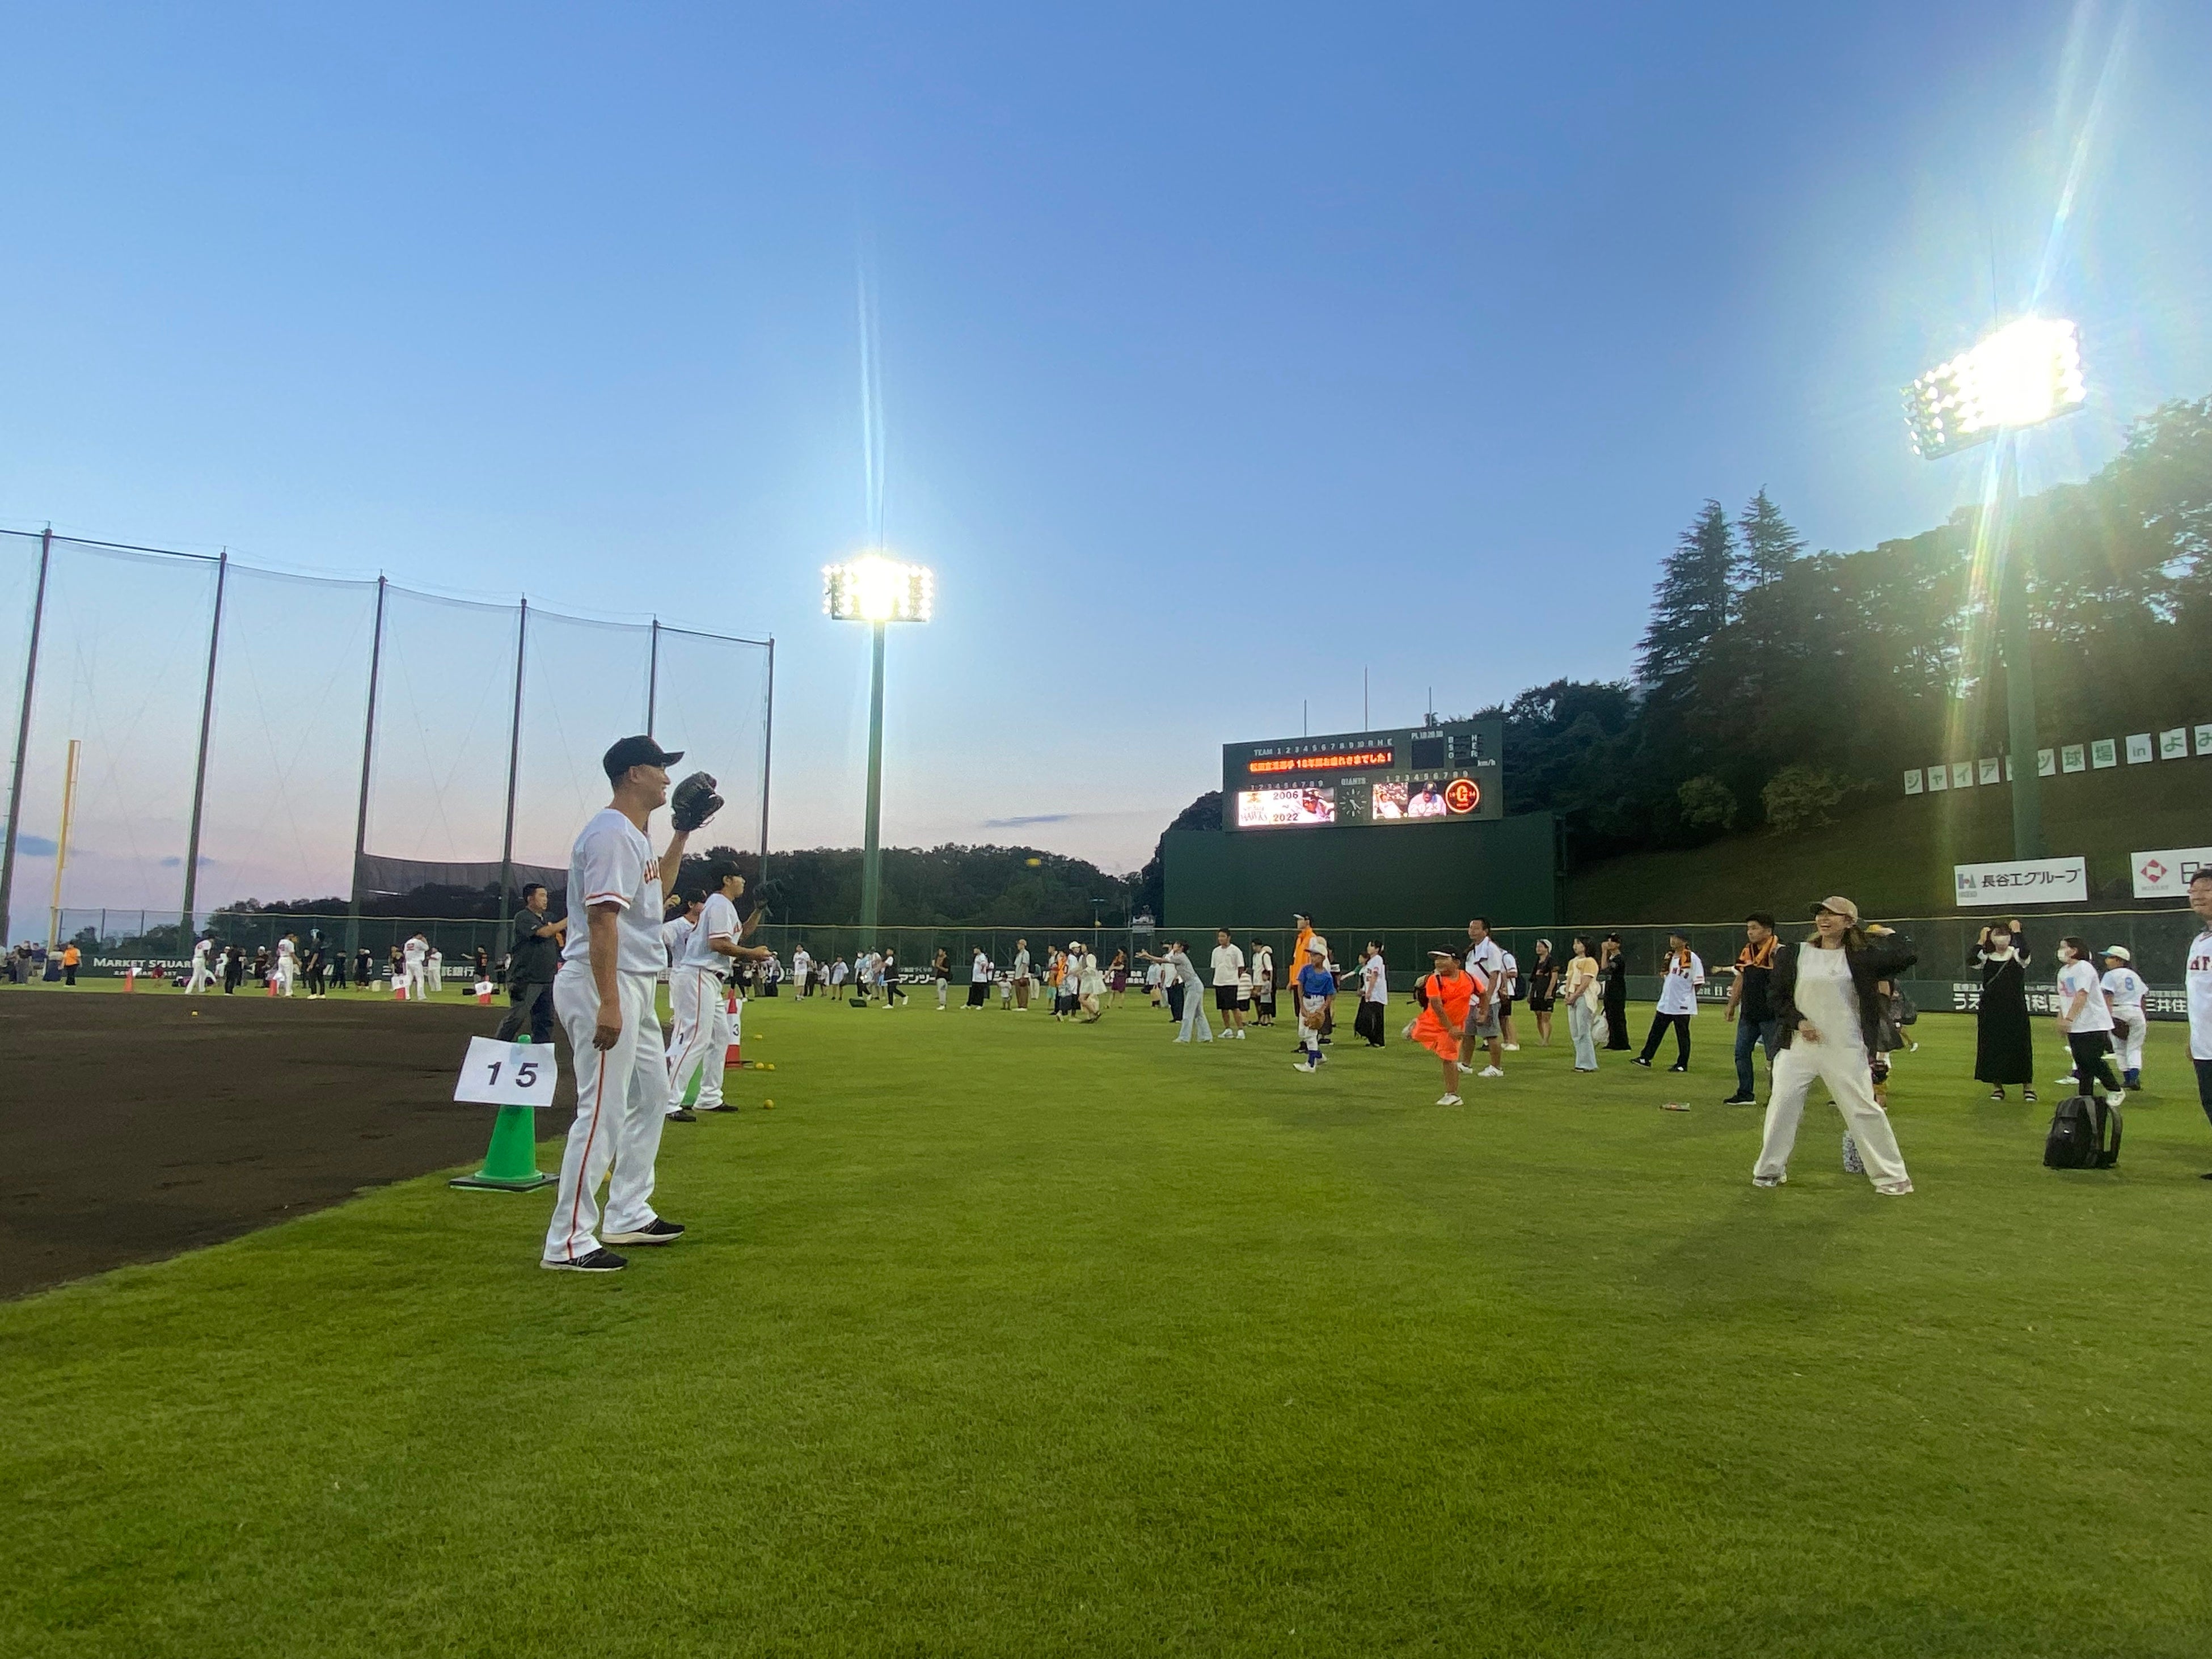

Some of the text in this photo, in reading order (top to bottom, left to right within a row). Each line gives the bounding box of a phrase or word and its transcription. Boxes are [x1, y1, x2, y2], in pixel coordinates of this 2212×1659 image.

[1341, 777, 1366, 786] GIANTS
[1273, 791, 1298, 800] 2006
[1410, 803, 1441, 813] 2023
[1981, 868, 2082, 888] 長谷工グループ
[94, 957, 146, 968] MARKET
[2125, 977, 2134, 991] 8
[487, 1061, 538, 1088] 15
